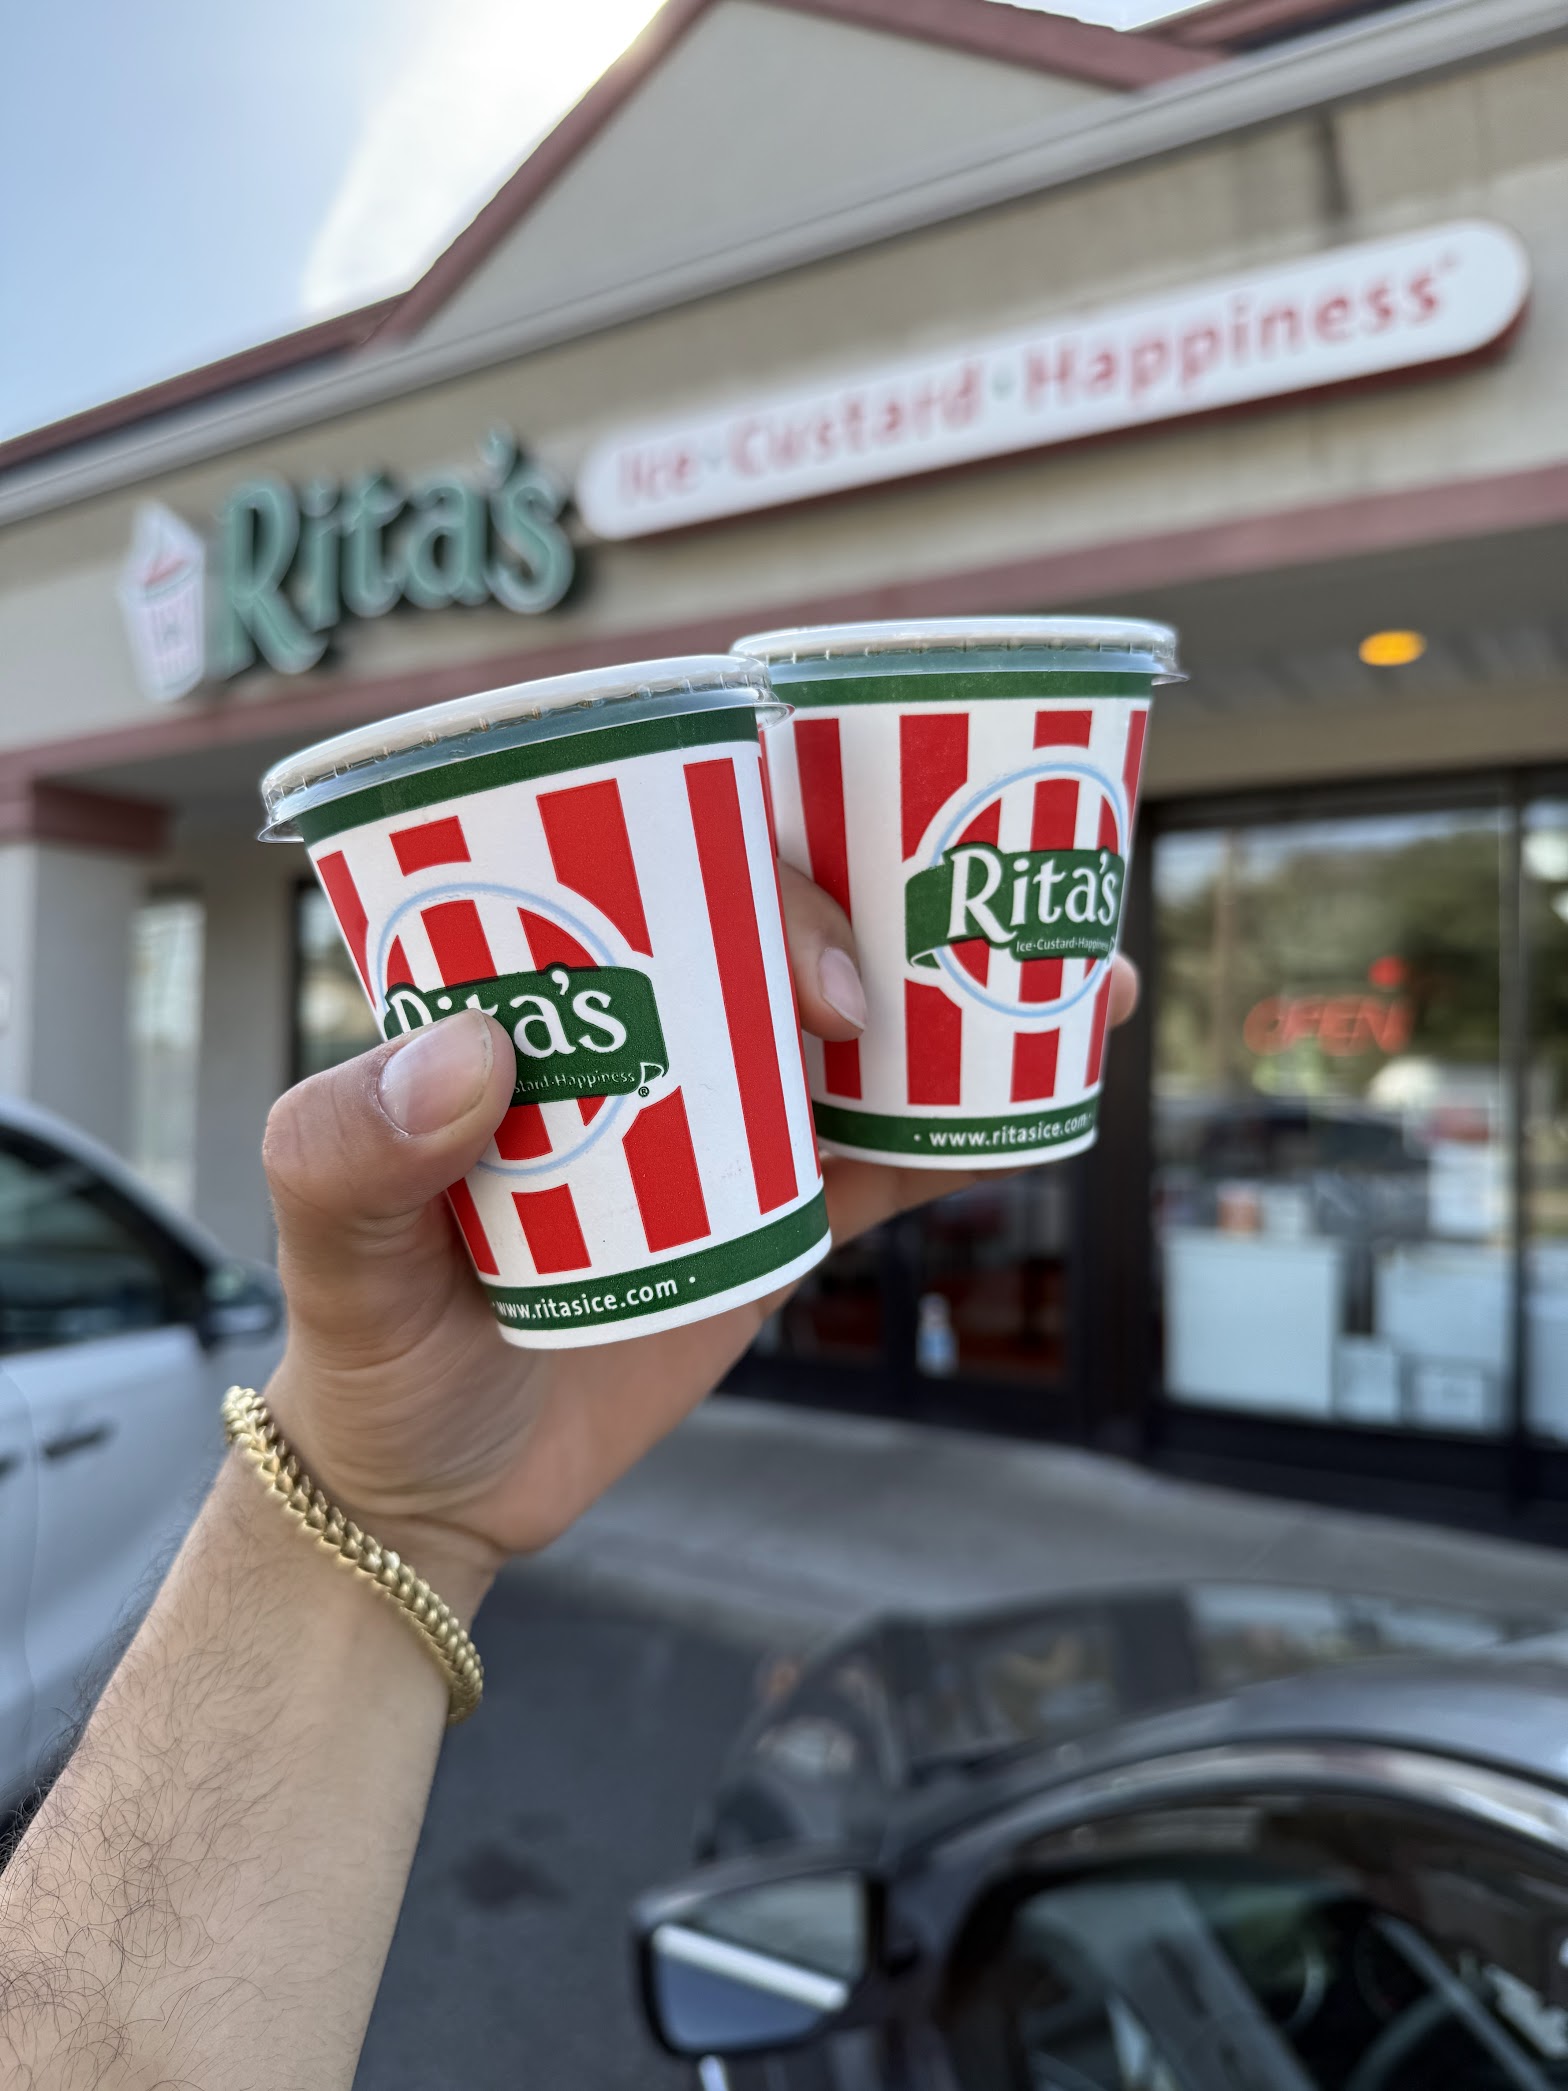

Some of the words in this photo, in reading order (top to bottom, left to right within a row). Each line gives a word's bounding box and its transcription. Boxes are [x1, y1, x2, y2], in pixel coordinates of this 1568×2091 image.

[208, 424, 575, 678] Rita's
[947, 848, 1117, 944] Rita's
[390, 970, 628, 1059] a's
[1243, 995, 1411, 1056] OPEN
[514, 1075, 550, 1094] stard
[929, 1113, 1089, 1148] www.ritasice.com
[497, 1278, 679, 1320] www.ritasice.com
